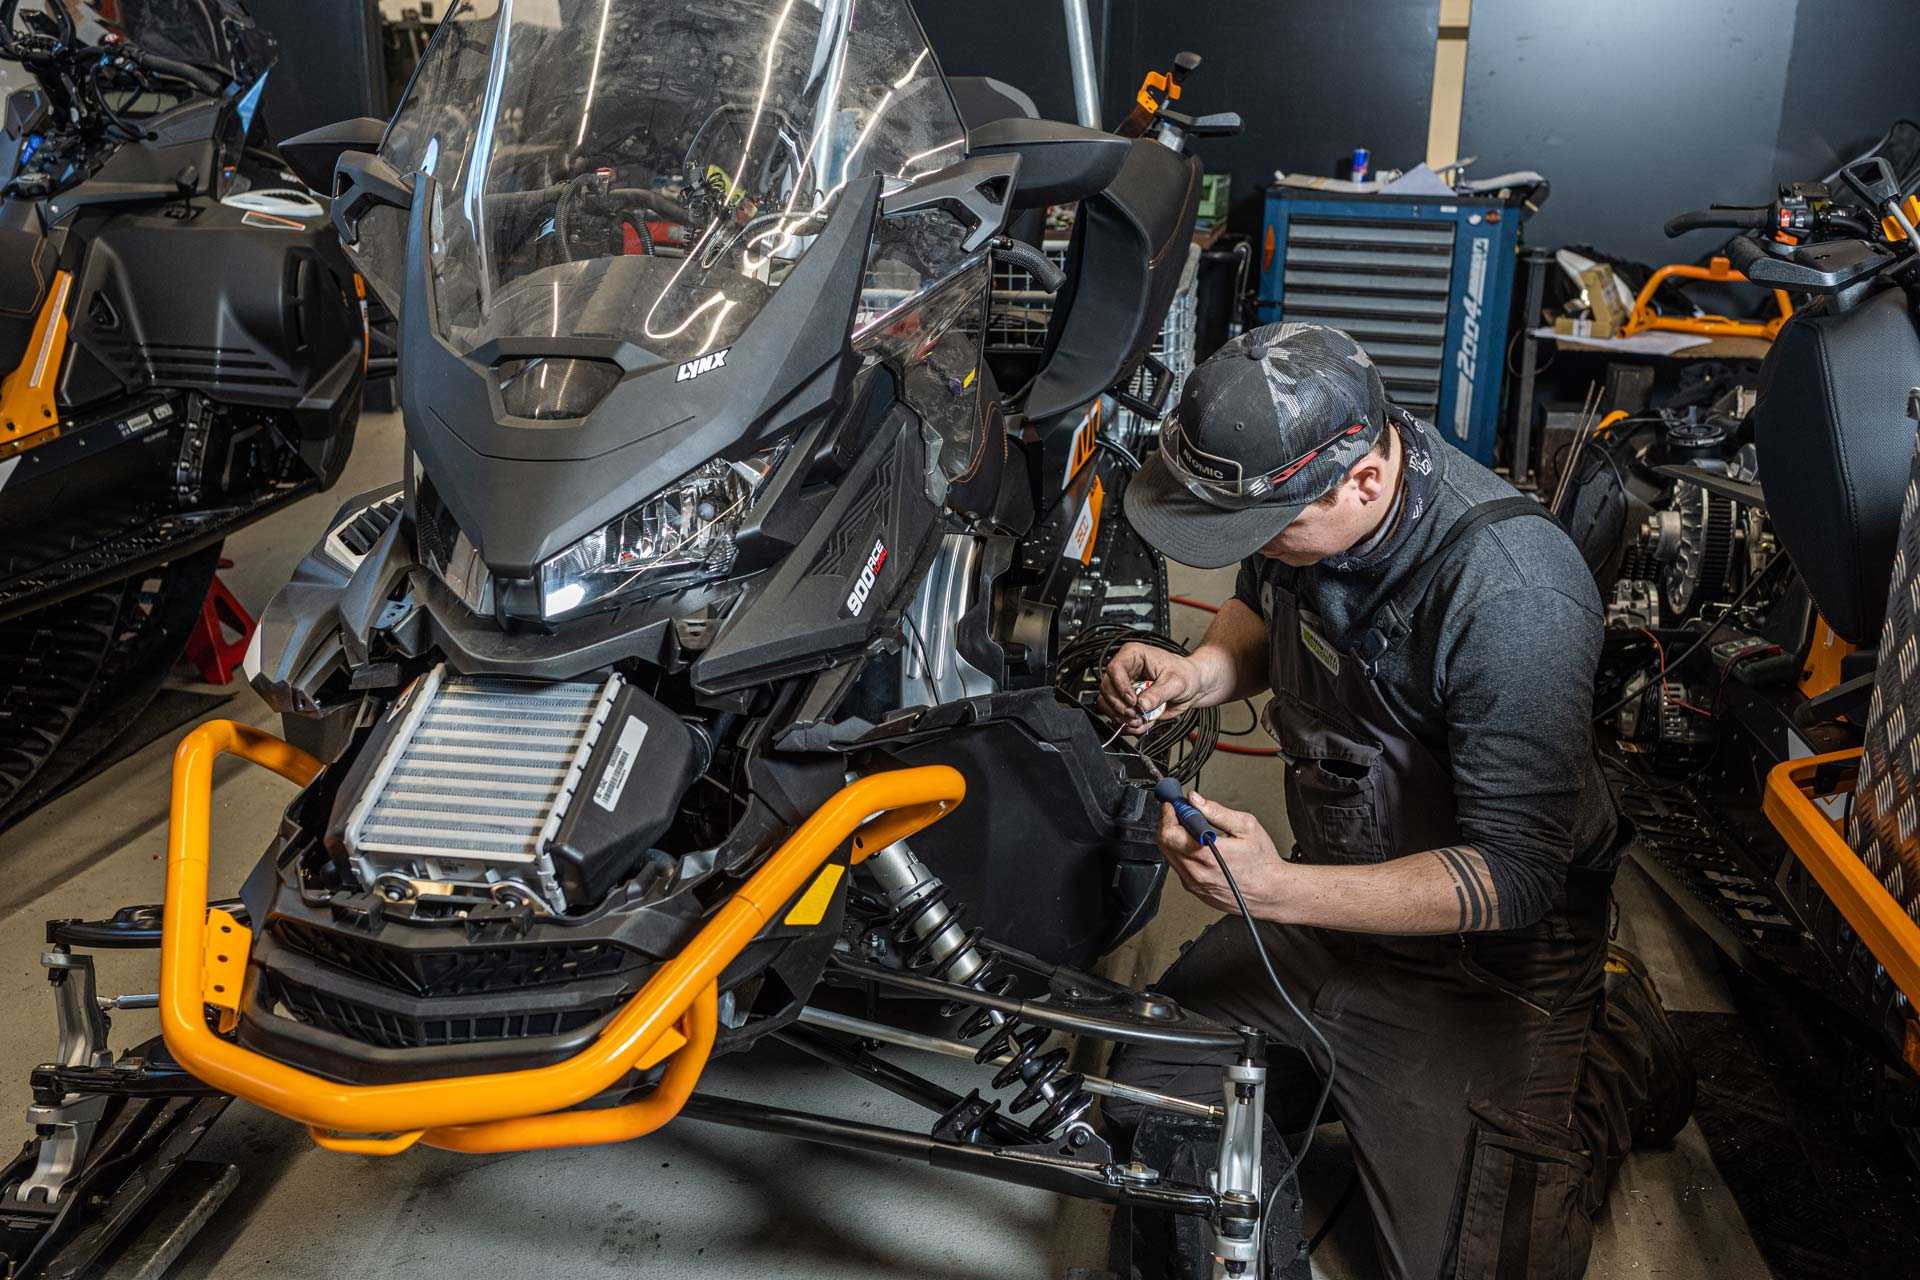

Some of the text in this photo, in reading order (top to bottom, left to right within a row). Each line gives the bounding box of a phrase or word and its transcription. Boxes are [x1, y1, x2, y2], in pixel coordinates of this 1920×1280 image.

[1457, 295, 1481, 381] 2004
[676, 348, 729, 382] LYNX
[847, 565, 876, 617] 900
